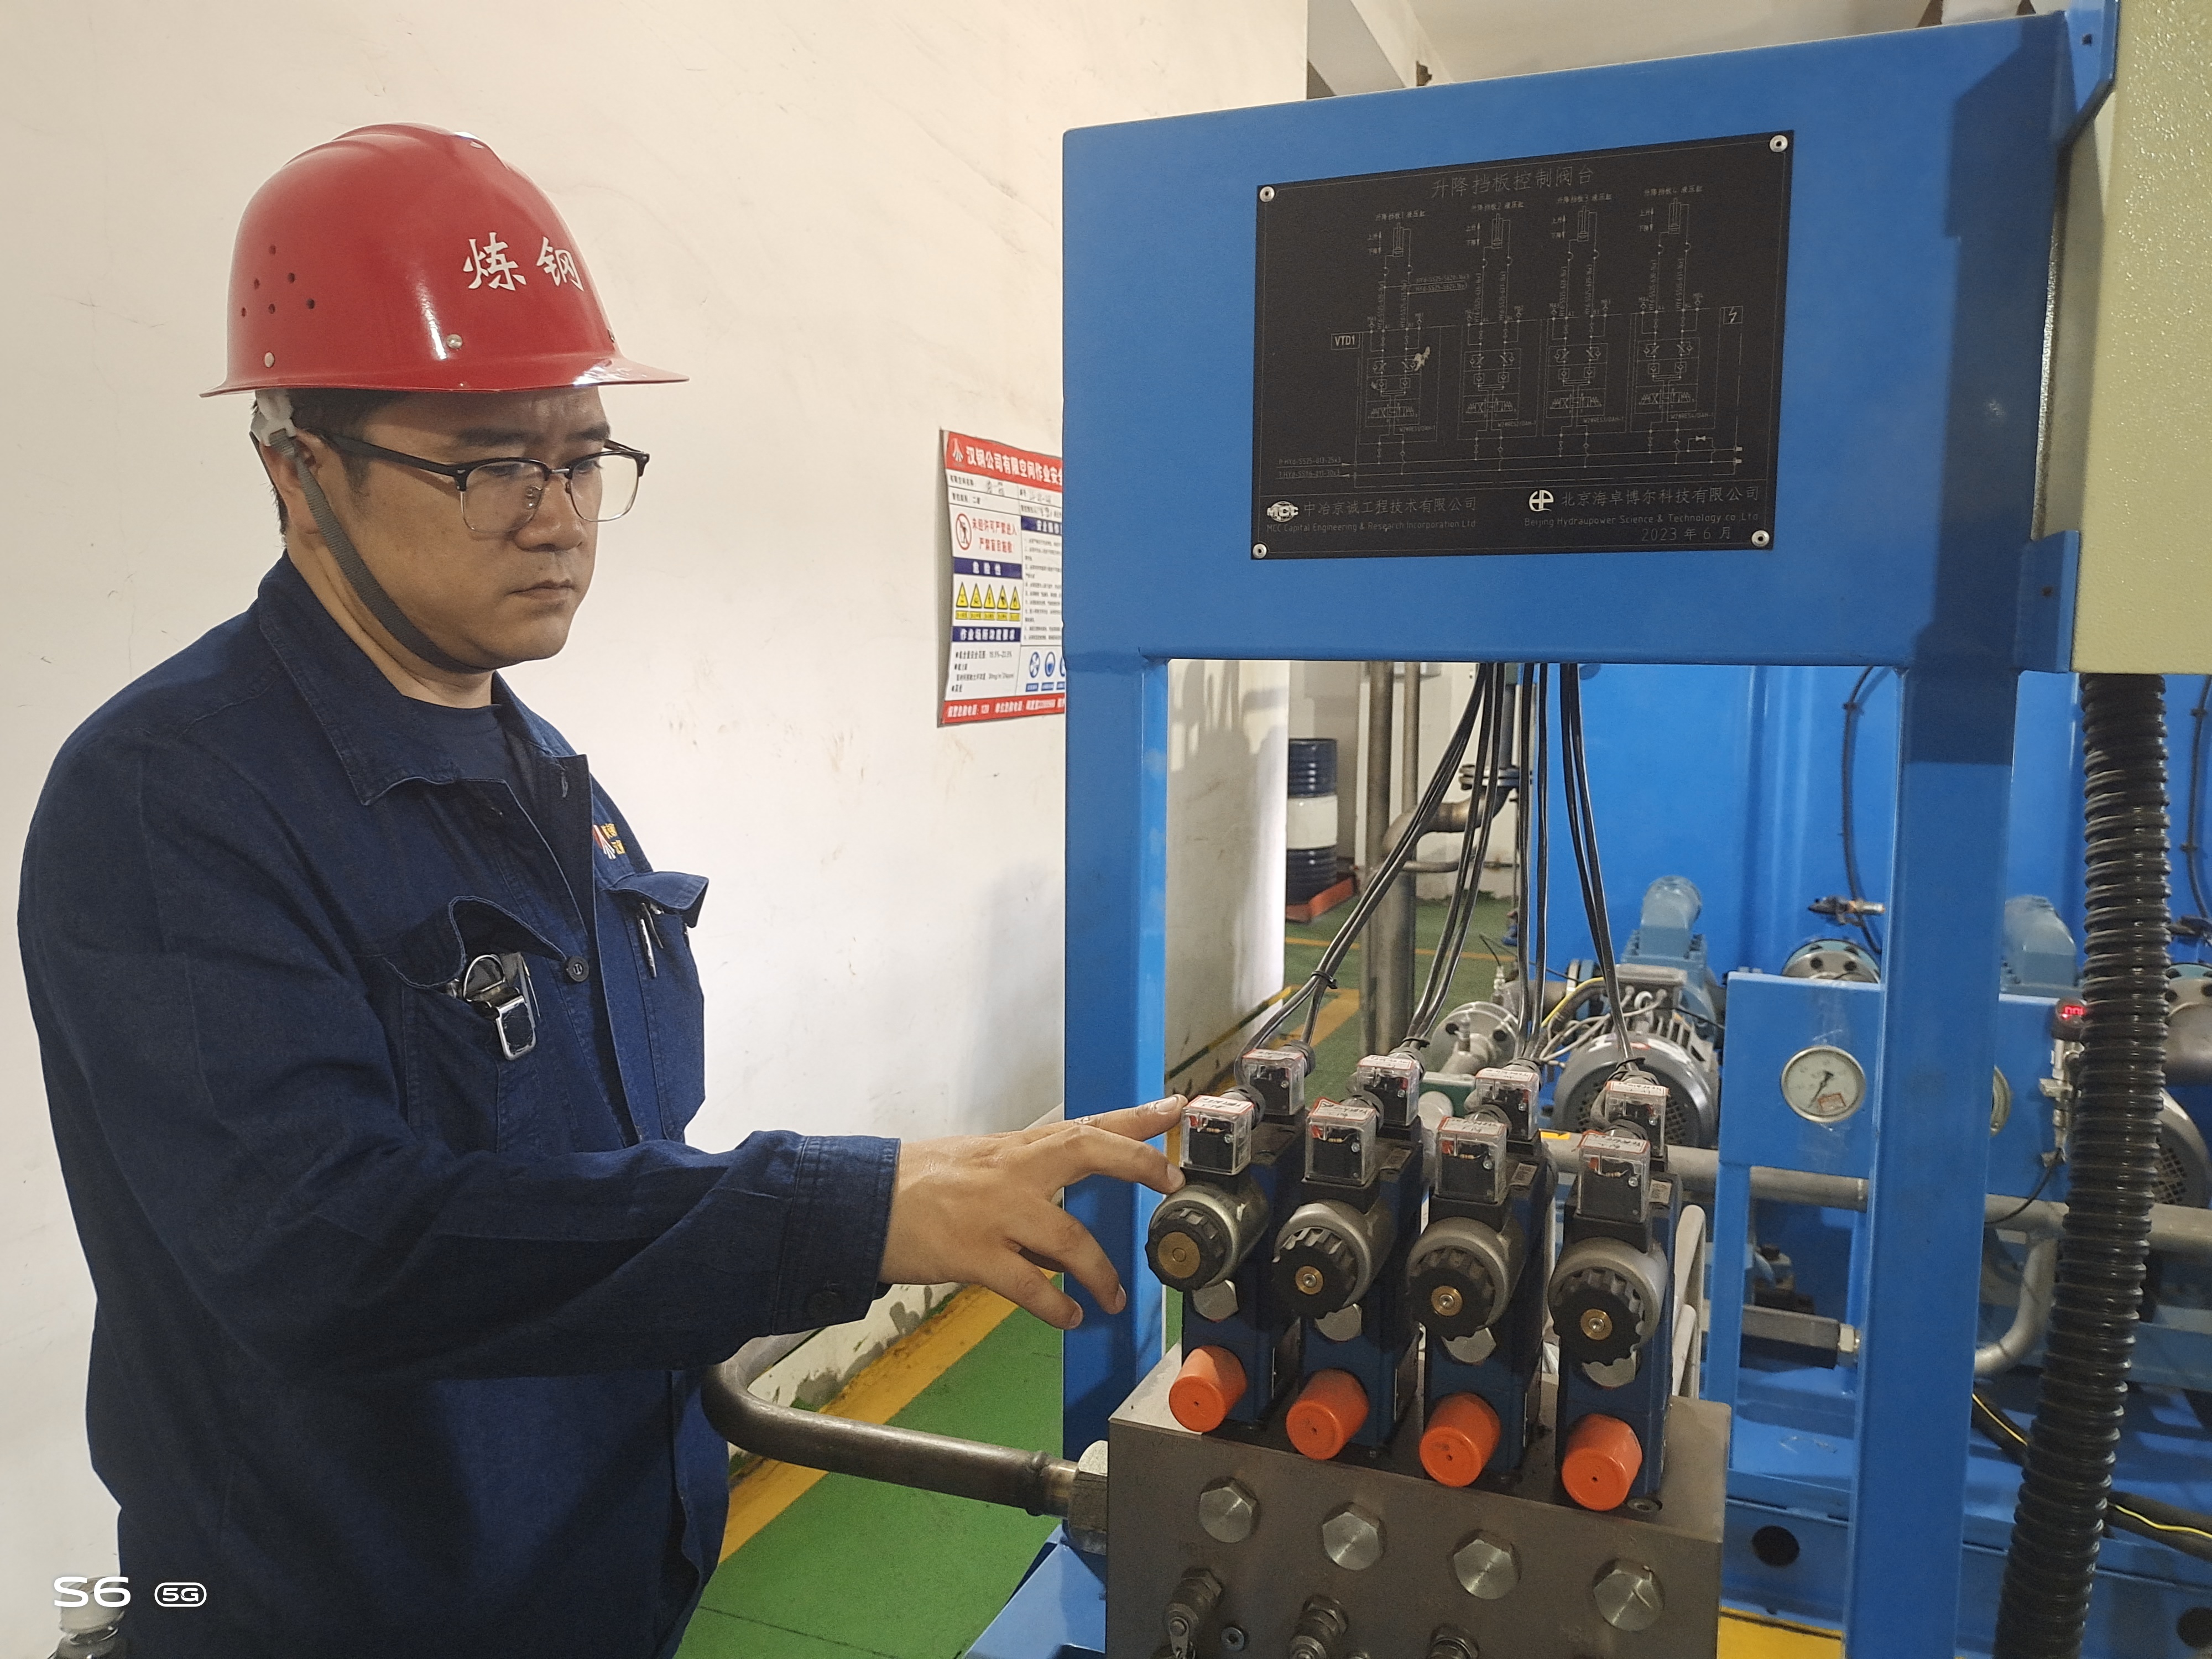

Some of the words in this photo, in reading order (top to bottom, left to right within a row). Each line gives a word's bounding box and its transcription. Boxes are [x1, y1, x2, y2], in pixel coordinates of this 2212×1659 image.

[1431, 164, 1593, 198] 升降挡板控制阀台
[463, 232, 584, 291] 炼钢
[1334, 335, 1355, 346] VTD1
[1562, 486, 1759, 507] 北京海卓博尔科技有限公司
[1266, 506, 1299, 517] MCC
[1304, 497, 1476, 517] 中冶京诚工程技术有限公司
[1267, 524, 1281, 533] MCC
[1284, 524, 1310, 534] Capital
[1313, 523, 1357, 534] Engineering
[1368, 521, 1405, 530] Research
[1407, 520, 1459, 529] Incorporation
[1524, 518, 1554, 528] Beijing
[1557, 517, 1616, 528] Hydraupower
[1620, 515, 1653, 524] Science
[1657, 514, 1663, 523] &
[1668, 513, 1721, 524] Technology
[1641, 527, 1677, 541] 2023
[1684, 527, 1697, 541] 年
[1703, 526, 1712, 540] 6
[1719, 526, 1730, 540] 月
